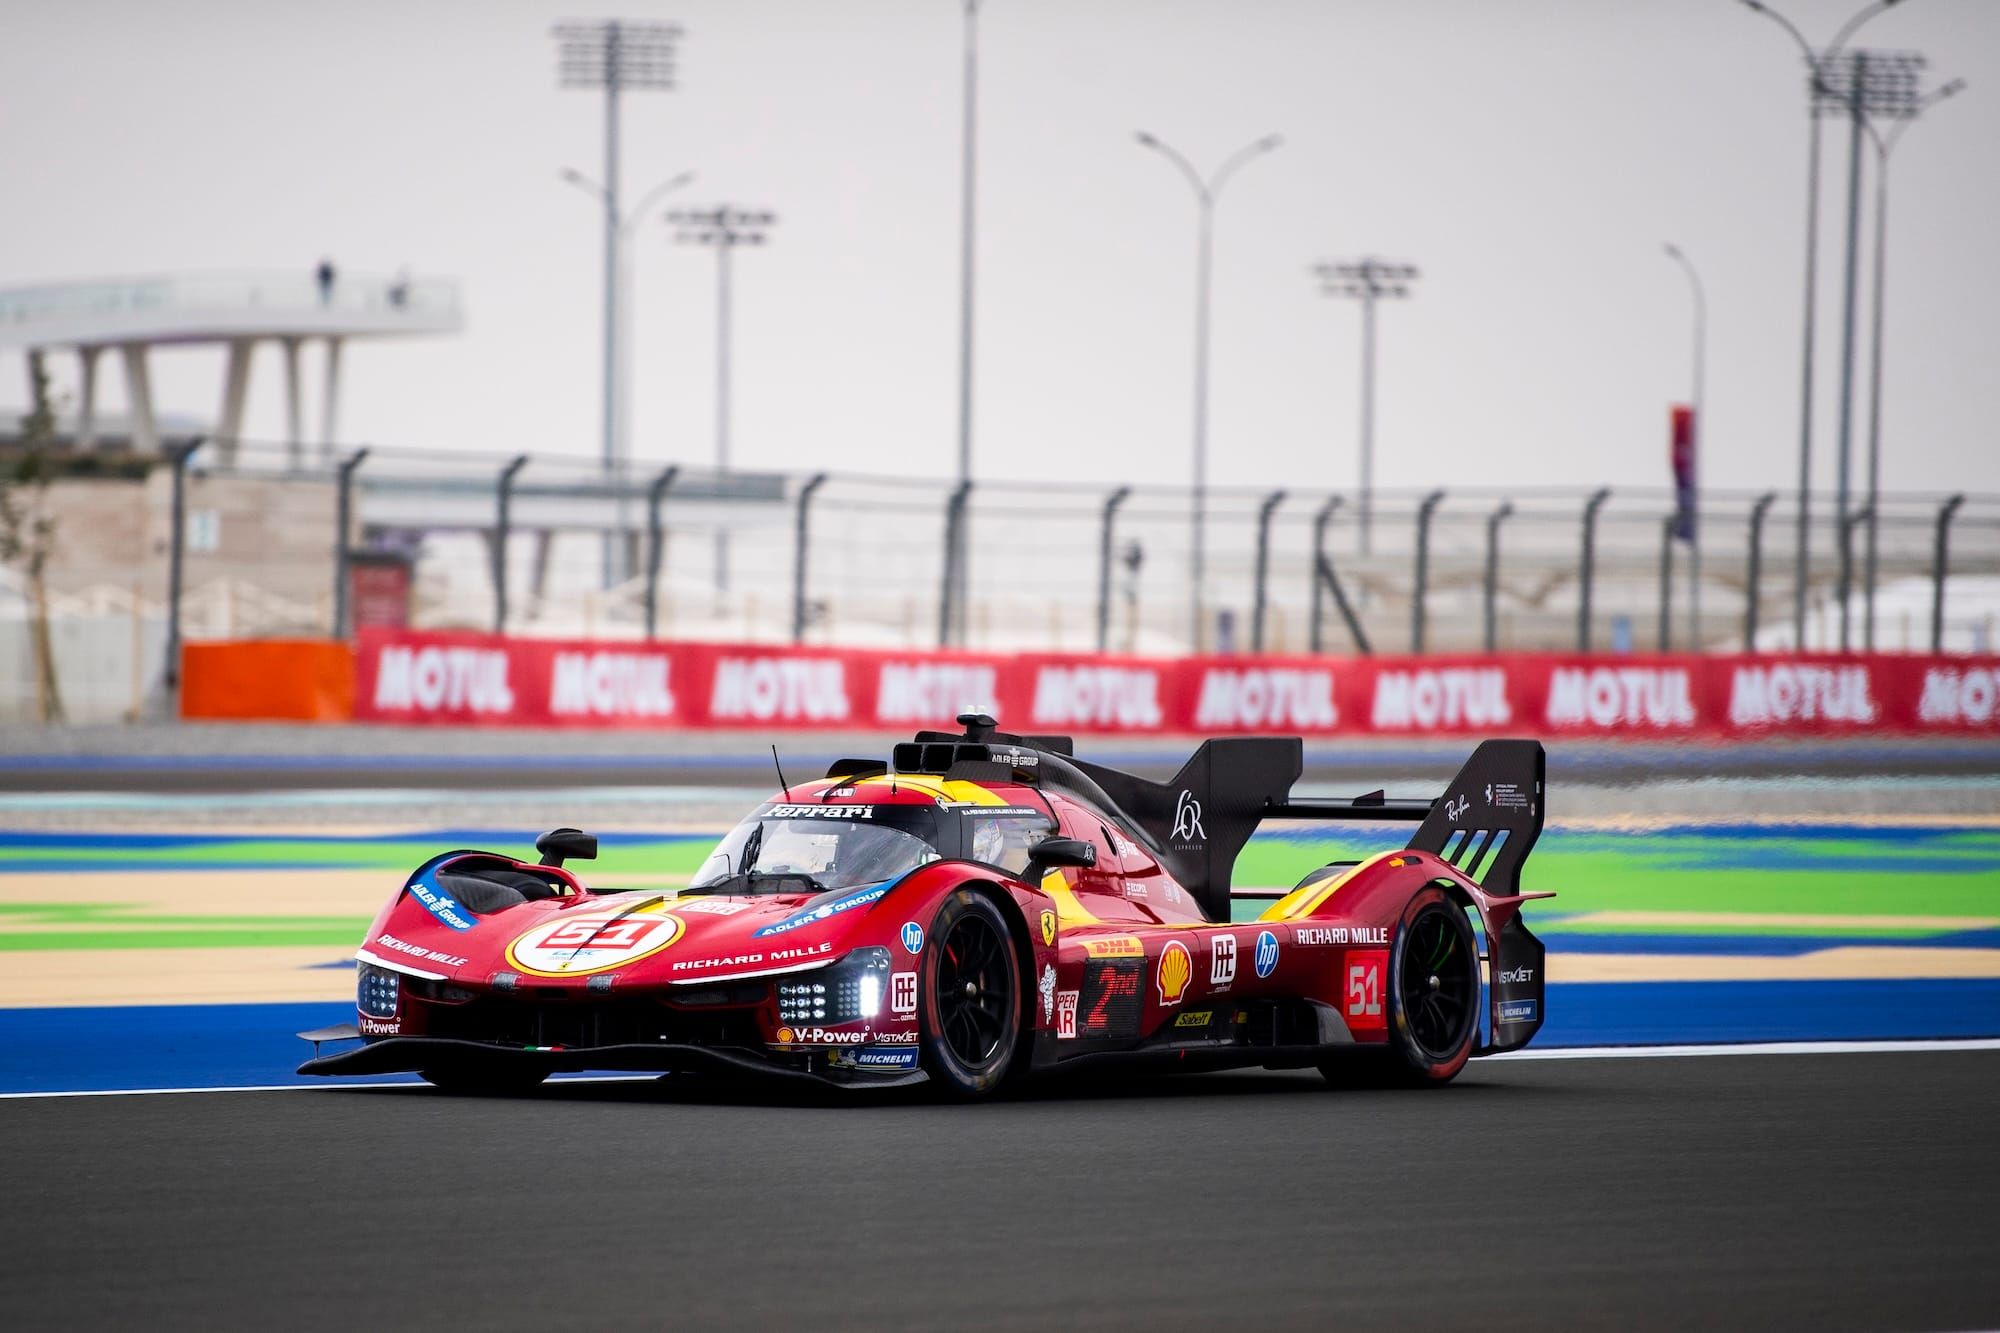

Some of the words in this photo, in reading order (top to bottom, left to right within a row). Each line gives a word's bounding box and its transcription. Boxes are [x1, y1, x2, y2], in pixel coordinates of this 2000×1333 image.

[375, 645, 513, 713] MOTUL
[549, 652, 674, 716] MOTUL
[710, 658, 850, 719] MOTUL
[1032, 665, 1163, 727] MOTUL
[1371, 669, 1511, 728] MOTUL
[1545, 667, 1696, 729] MOTUL
[1729, 663, 1874, 725] MOTUL
[1195, 669, 1338, 729] MOTUL
[991, 753, 1011, 764] ADLER
[1019, 756, 1039, 767] GROUP
[761, 804, 874, 819] Ferrari
[410, 883, 437, 906] ADLER
[437, 908, 471, 929] GROUP
[761, 915, 816, 936] ADLER
[834, 889, 886, 912] GROUP
[377, 934, 427, 957] RICHARD
[424, 951, 469, 967] MILLE
[544, 920, 648, 946] 51
[905, 923, 922, 953] hp
[1095, 940, 1136, 954] DHL
[1296, 928, 1348, 945] RICHARD
[1351, 927, 1388, 944] MILLE
[672, 954, 763, 971] RICHARD
[770, 942, 833, 961] MILLE
[1257, 932, 1277, 977] hp
[1057, 994, 1077, 1009] PER
[1349, 964, 1381, 1016] 51
[361, 1019, 401, 1034] V-Power
[794, 1028, 868, 1043] V-Power
[858, 1054, 913, 1064] MICHELIN
